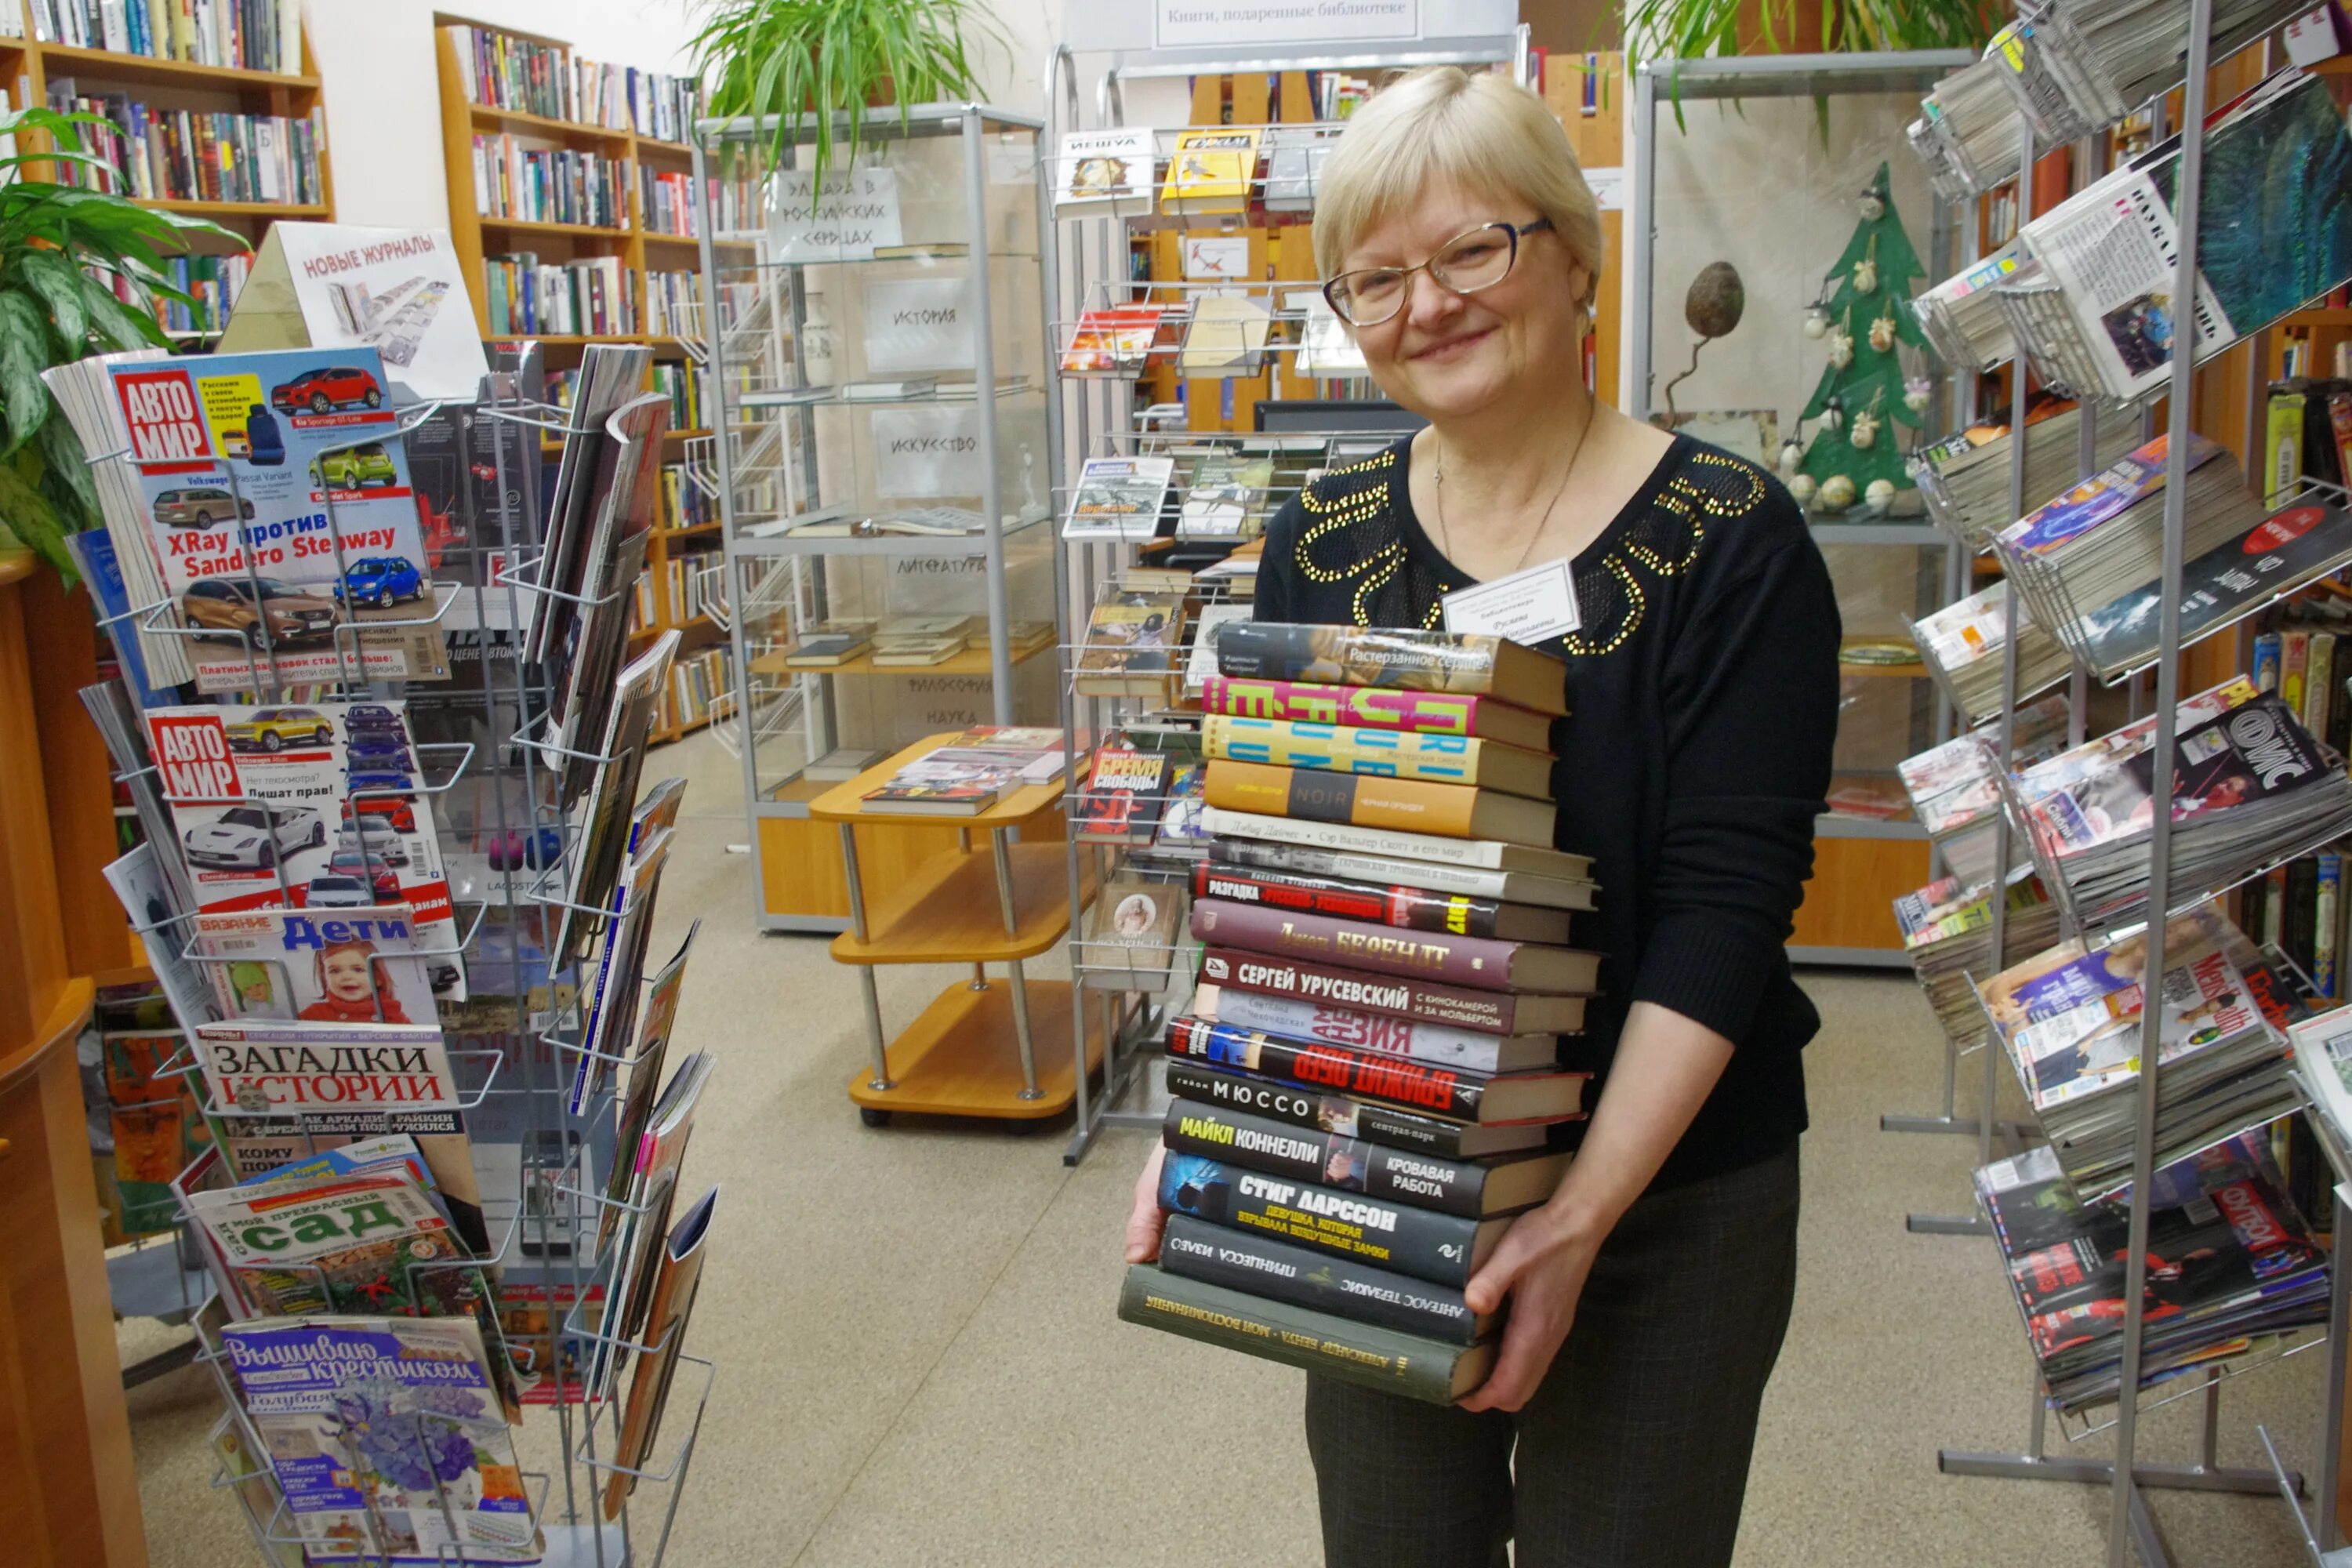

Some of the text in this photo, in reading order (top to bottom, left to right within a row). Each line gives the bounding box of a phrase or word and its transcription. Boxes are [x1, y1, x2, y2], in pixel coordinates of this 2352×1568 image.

[1168, 1, 1406, 24] Книги, подаренные библиотеке
[260, 128, 271, 149] Б
[1070, 138, 1137, 151] ИЕШУА
[802, 230, 873, 245] СЕРДЦАХ
[303, 234, 436, 279] НОВЫЕ ЖУРНАЛЫ
[894, 308, 956, 326] ИСТОРИЯ
[126, 379, 194, 424] АВТО
[133, 421, 202, 461] МИР
[891, 436, 977, 455] ИСКУССТВО
[187, 475, 230, 487] Volkswage
[263, 470, 293, 481] Variant
[167, 528, 229, 555] XRay
[183, 547, 285, 579] Sandero
[896, 558, 986, 574] ЛИТЕРАТУРА
[1349, 648, 1436, 666] Растерзанное
[927, 710, 978, 726] НАУКА
[161, 724, 226, 762] АВТО
[2228, 708, 2307, 791] ФИС
[167, 760, 233, 798] МИР
[246, 772, 321, 786] Нет техосмотра?
[1097, 757, 1165, 778] БРЕМЯ
[296, 784, 334, 800] прав!
[1093, 774, 1162, 791] СВОБОДЫ
[1296, 787, 1348, 804] NOIR
[1319, 831, 1338, 845] Сэр
[1338, 833, 1378, 849] Вальтер
[1380, 837, 1409, 852] Скотт
[1421, 843, 1439, 855] его
[1441, 848, 1465, 859] мир
[1208, 878, 1260, 902] РАЗГАДКА
[200, 916, 272, 931] ВЯЗАНИЕ
[281, 914, 410, 952] Дети
[1238, 962, 1410, 1011] СЕРГЕЙ УРУСЕВСКИЙ
[1415, 992, 1499, 1015] С КИНОКАМЕРОЙ
[1414, 1005, 1503, 1028] И ЗА МОЛЬБЕРТОМ
[399, 1032, 434, 1040] ФАКТЫ
[213, 1045, 434, 1079] ЗАГАДКИ
[218, 1075, 445, 1105] ИСТОРИИ
[1213, 1080, 1309, 1117] МЮССО
[396, 1111, 454, 1123] РАЙКИН
[1178, 1116, 1320, 1164] МАЙКЛ КОННЕЛЛИ
[1370, 1120, 1437, 1143] сентрал-парк
[237, 1147, 292, 1160] КОМУ
[1386, 1157, 1456, 1185] КРОВАВАЯ
[1392, 1174, 1443, 1199] РАБОТА
[271, 1192, 382, 1222] ПРЕКРАСНЫЙ
[1239, 1174, 1399, 1232] СТИГ ЛАРССОН
[1265, 1204, 1363, 1240] ДЕВУШКА, КОТОРАЯ
[1352, 1240, 1391, 1261] ЗАМКИ
[1219, 1248, 1296, 1279] ПРИНЦЕССА
[1339, 1278, 1465, 1319] ТЕРЗАКИС АНГЕЛОС
[1144, 1294, 1241, 1329] ВОСПОМИНАНИЯ
[226, 1333, 378, 1367] Вышиваю
[1279, 1329, 1316, 1348] БЕНУА
[1316, 1338, 1391, 1368] АЛЕКСАНДР
